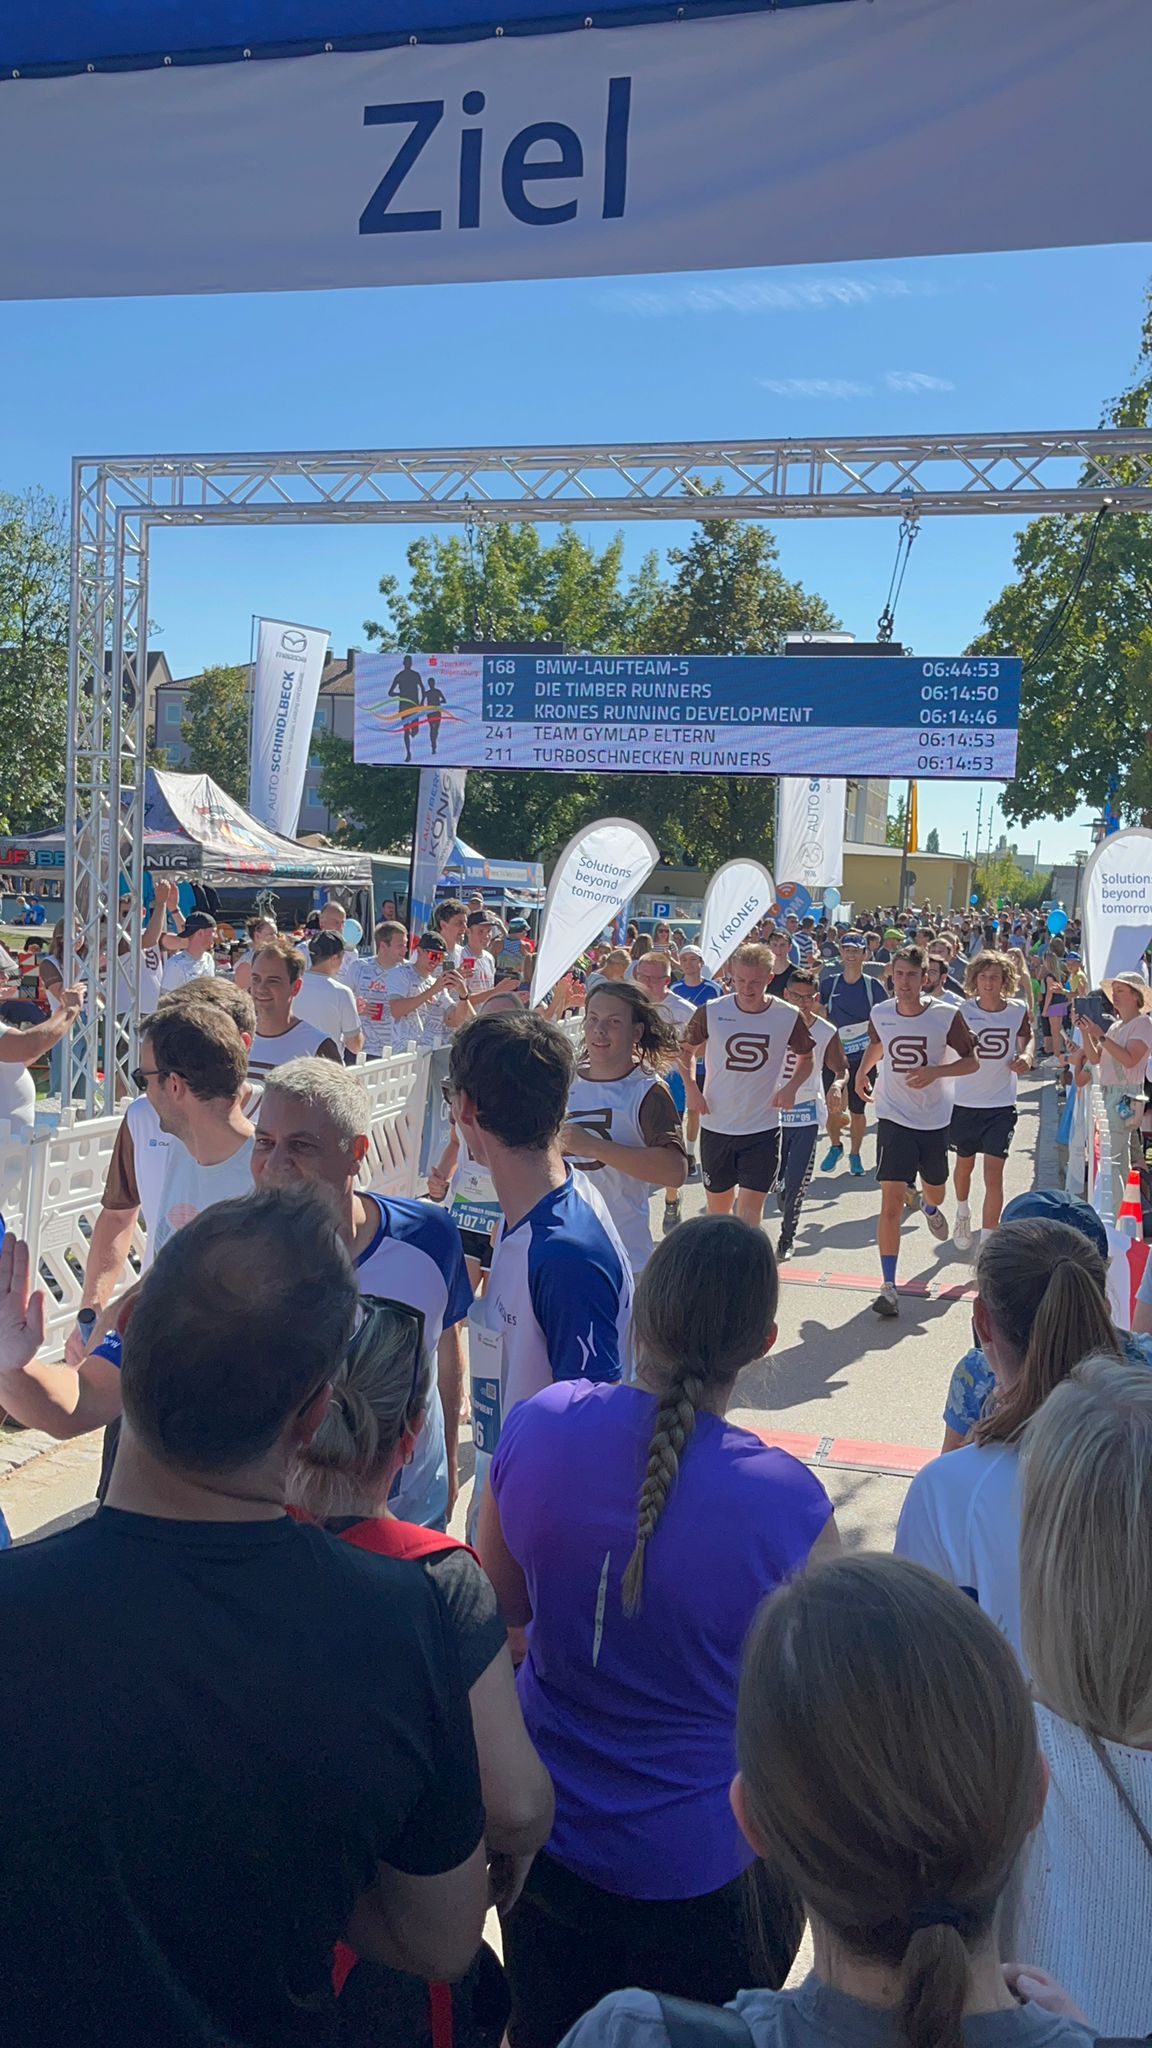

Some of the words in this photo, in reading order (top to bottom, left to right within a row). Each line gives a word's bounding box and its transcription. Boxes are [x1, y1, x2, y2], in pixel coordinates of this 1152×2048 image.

[359, 76, 631, 235] Ziel
[487, 660, 516, 675] 168
[536, 660, 689, 676] BMW-LAUFTEAM-5
[922, 662, 1000, 678] 06:44:53
[486, 682, 515, 696] 107
[535, 682, 561, 697] DIE
[564, 683, 629, 698] TIMBER
[632, 684, 712, 699] RUNNERS
[921, 685, 999, 701] 06:14:50
[271, 670, 295, 773] SCHINDLBECK
[486, 704, 514, 718] 122
[534, 704, 599, 719] KRONES
[603, 705, 680, 720] RUNNING
[685, 706, 813, 722] DEVELOPMENT
[919, 709, 998, 725] 06:14:46
[485, 726, 513, 739] 241
[534, 726, 579, 740] TEAM
[582, 727, 649, 742] GYMLAP
[653, 728, 716, 743] ELTERN
[918, 732, 995, 748] 06:14:53
[485, 747, 512, 761] 211
[534, 748, 684, 765] TURBOSCHNECKEN
[690, 751, 772, 767] RUNNERS
[917, 755, 994, 771] 06:14:53
[267, 774, 279, 810] AUTO
[807, 794, 820, 832] AUTO
[141, 856, 188, 867] NIG
[579, 856, 632, 878] Solutions
[575, 869, 619, 890] beyond
[1102, 888, 1146, 901] beyond
[657, 904, 667, 917] P
[719, 896, 759, 943] KRONES
[486, 1219, 495, 1232] 0
